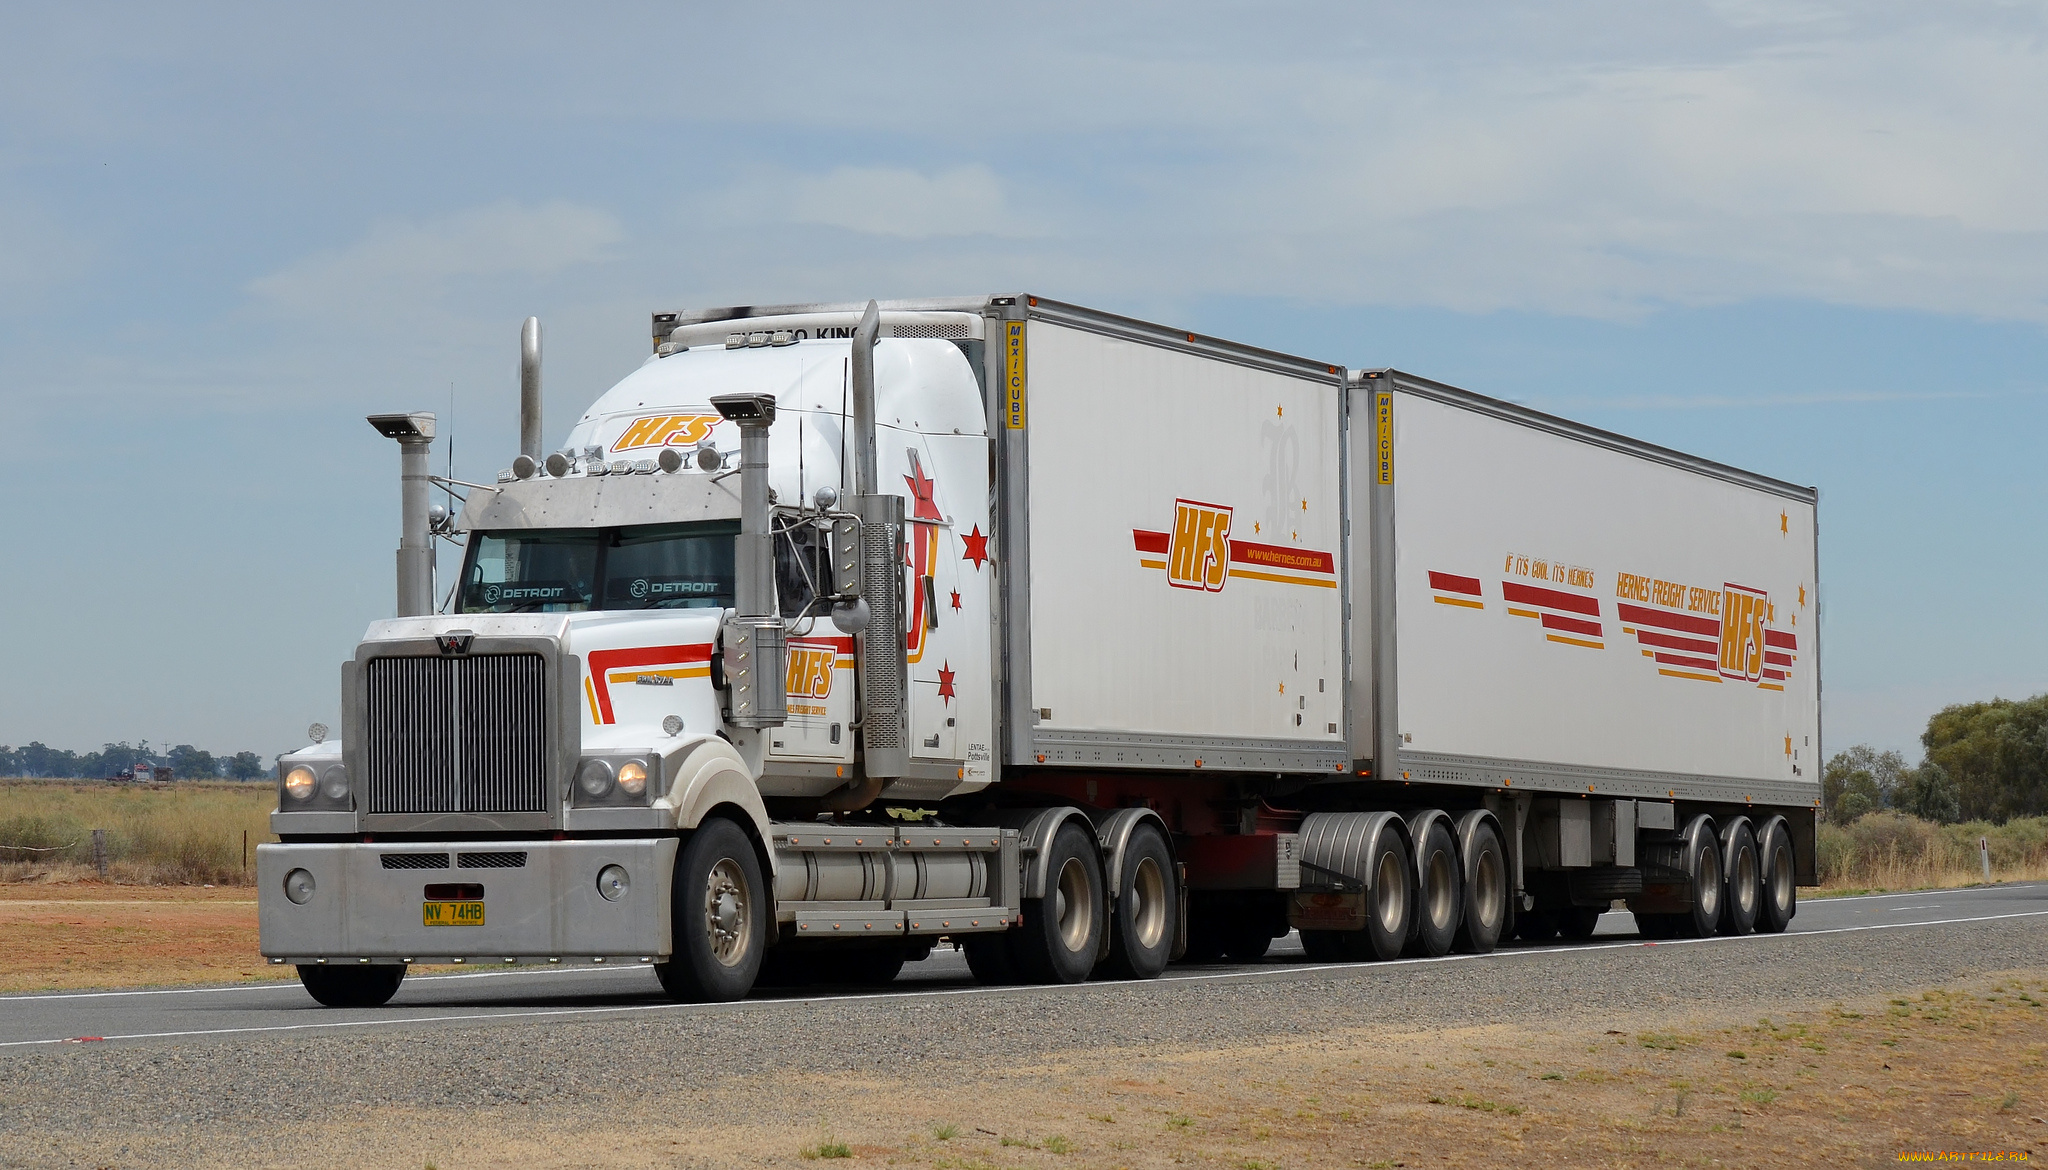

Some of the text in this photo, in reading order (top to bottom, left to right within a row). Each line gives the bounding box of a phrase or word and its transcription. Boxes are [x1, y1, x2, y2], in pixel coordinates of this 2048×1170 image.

[816, 326, 859, 340] KIN
[1009, 325, 1021, 426] Maxi-CUBE
[612, 414, 722, 451] HFS
[1380, 397, 1389, 482] Maxi-CUBE
[1170, 504, 1231, 586] HFS
[1246, 548, 1322, 568] www.hernes.com.au
[651, 582, 718, 593] DETROIT
[1504, 554, 1595, 589] IF ITS COOL ITS HERNES
[502, 587, 564, 599] DETROIT
[1616, 571, 1721, 616] HERNES FREIGHT SERVICE
[1720, 589, 1766, 676] HFS
[787, 649, 833, 695] HFS
[425, 903, 482, 920] NV 74HB
